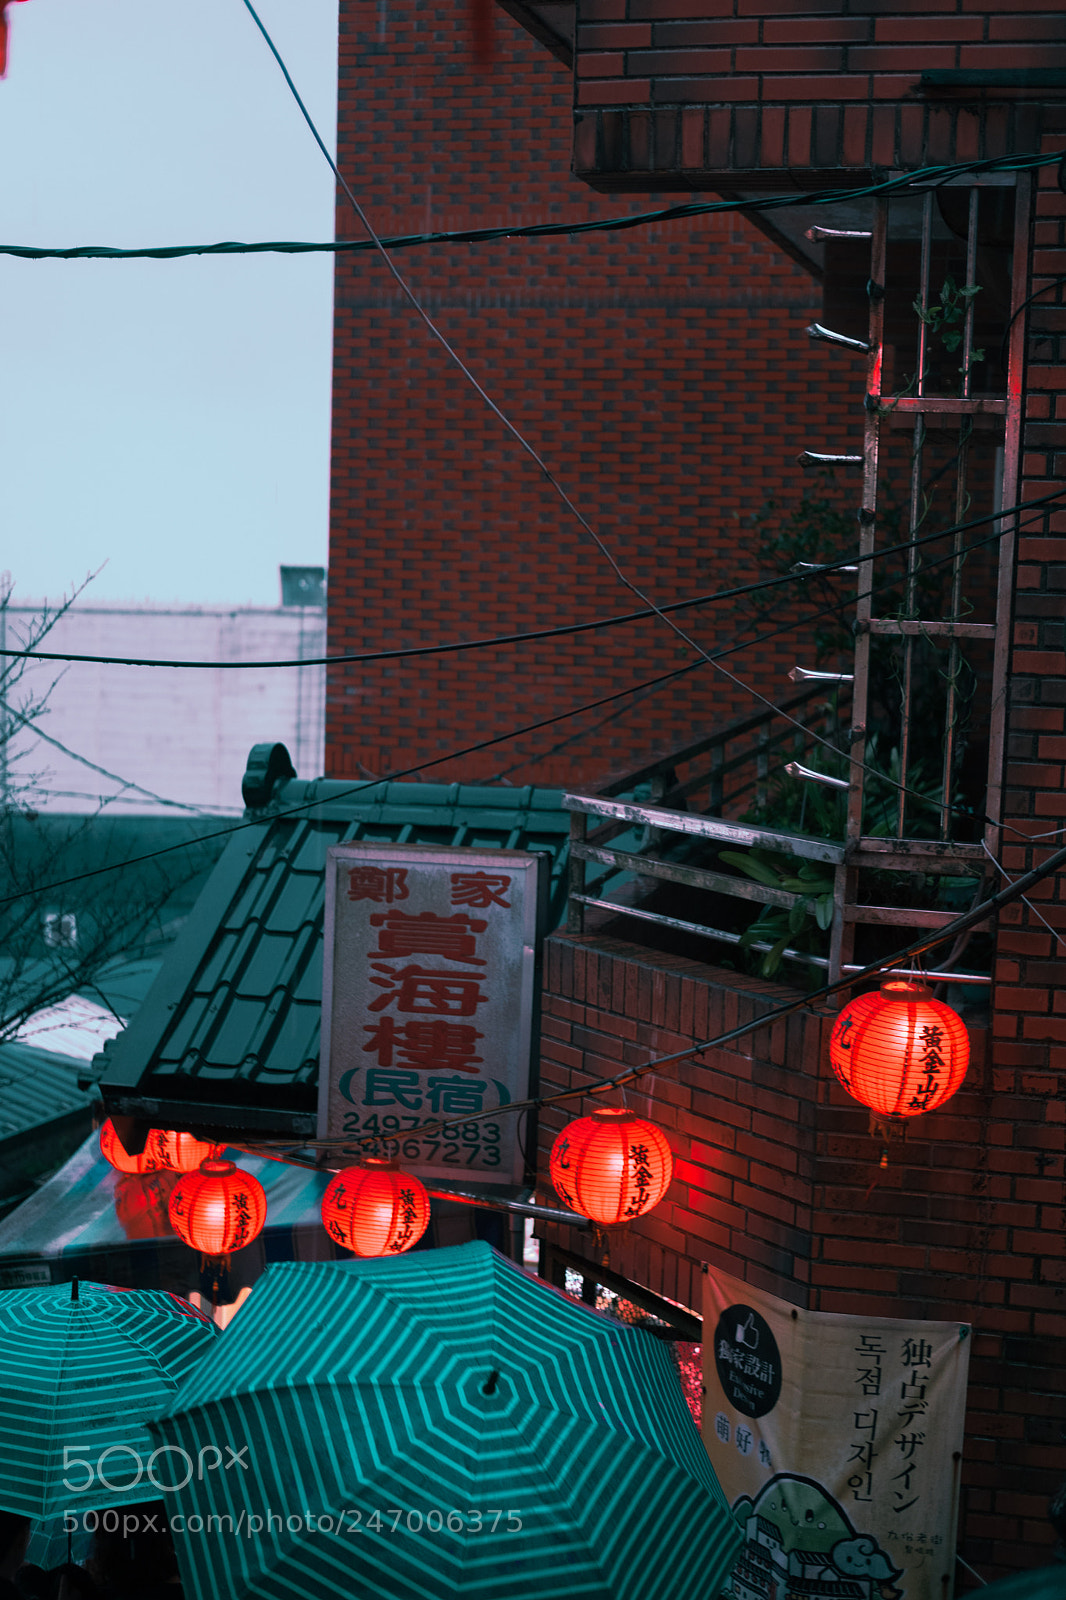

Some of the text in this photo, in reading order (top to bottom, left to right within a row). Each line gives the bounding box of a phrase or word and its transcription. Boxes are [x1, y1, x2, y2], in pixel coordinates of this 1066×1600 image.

[347, 866, 511, 909] 鄭家
[362, 909, 489, 1074] 賞海樓
[847, 1334, 887, 1502] 독점 디자인
[891, 1337, 933, 1513] 独占デザイン
